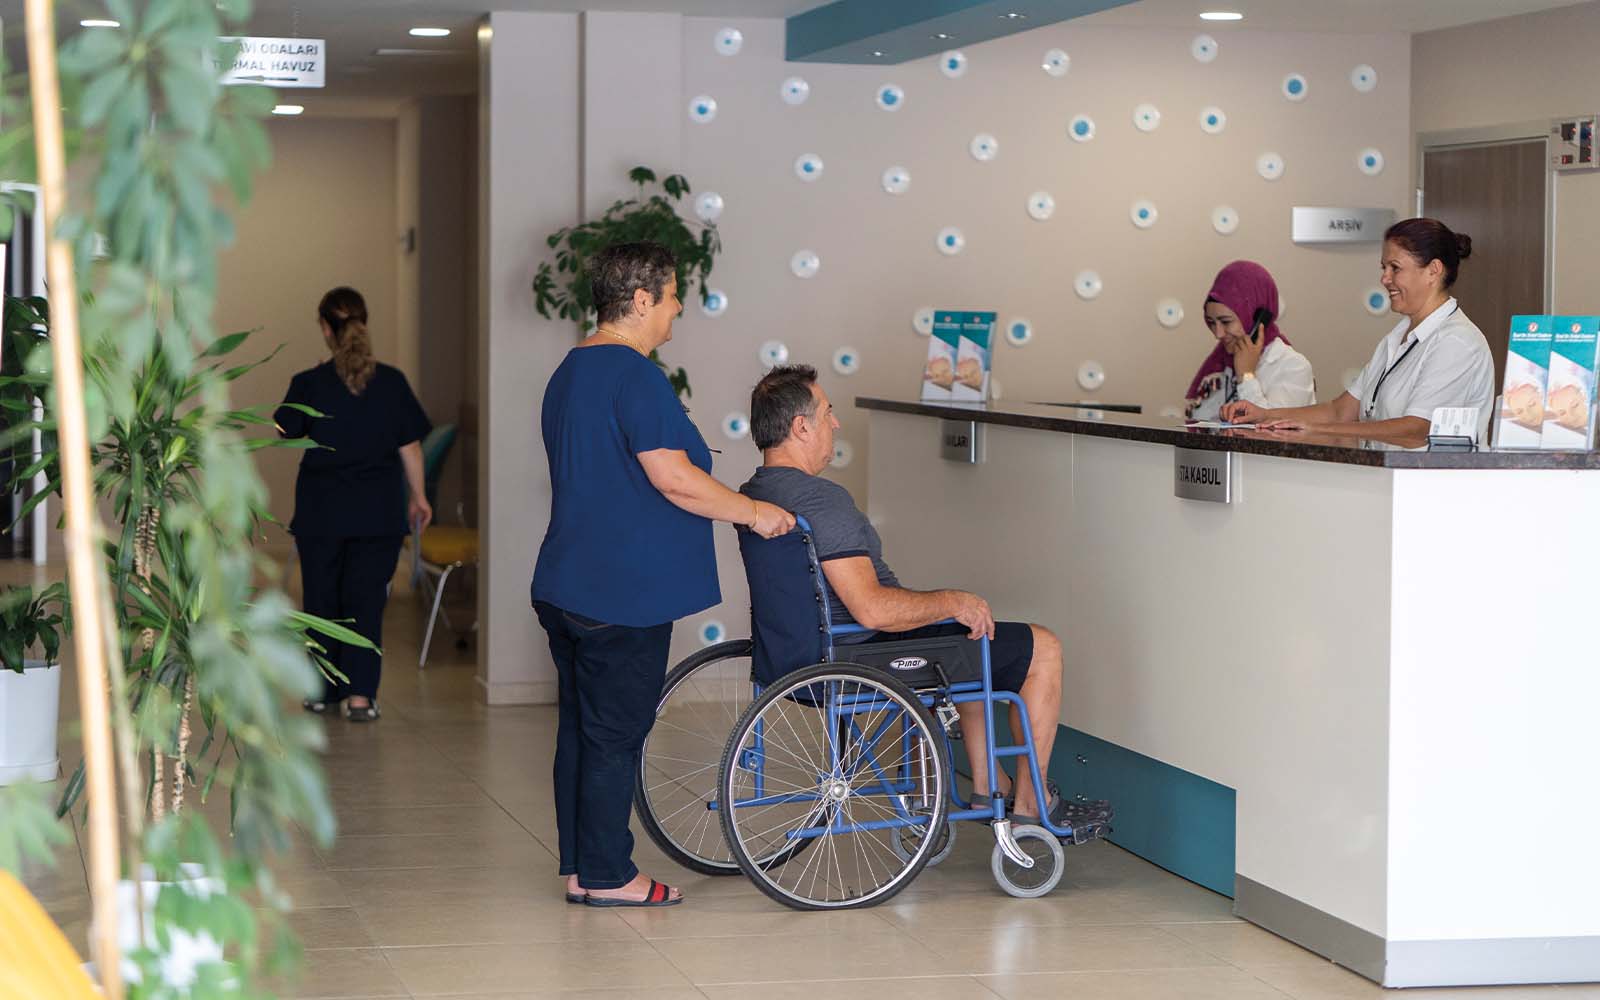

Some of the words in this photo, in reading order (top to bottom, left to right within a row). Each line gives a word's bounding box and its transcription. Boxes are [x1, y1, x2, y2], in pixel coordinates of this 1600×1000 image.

[260, 43, 319, 55] ODALARI
[271, 61, 316, 72] HAVUZ
[1191, 466, 1221, 485] KABUL
